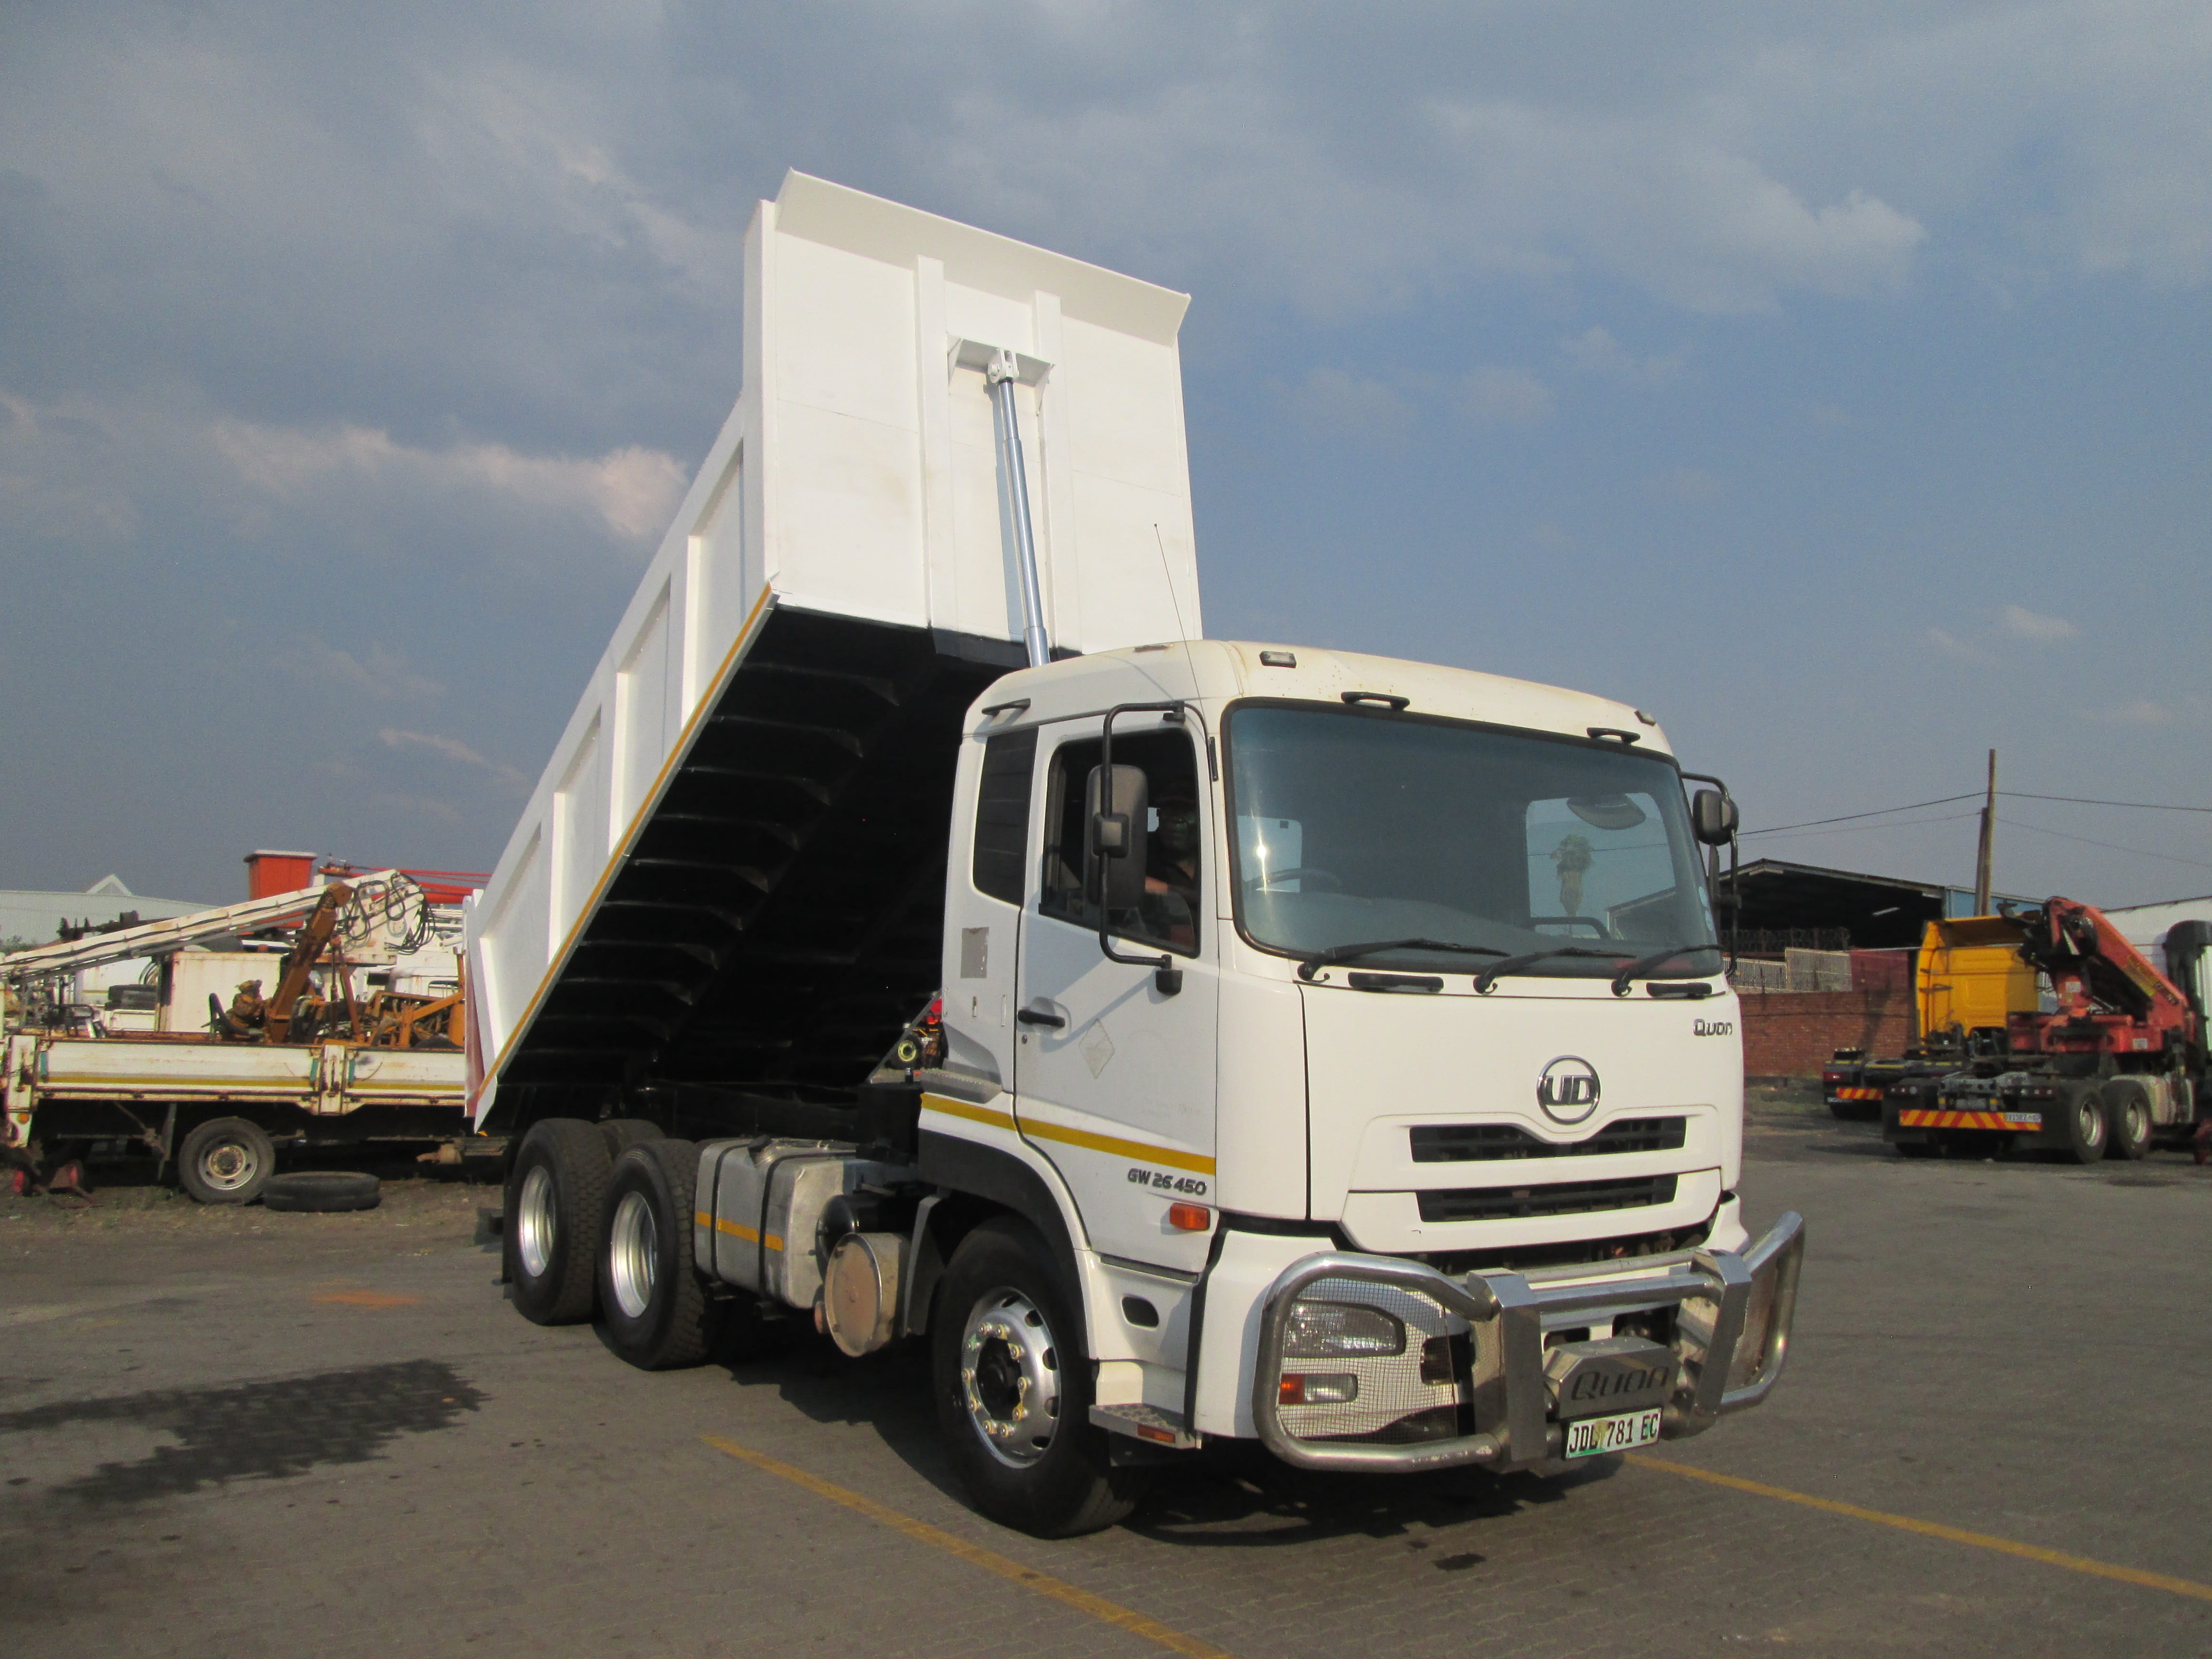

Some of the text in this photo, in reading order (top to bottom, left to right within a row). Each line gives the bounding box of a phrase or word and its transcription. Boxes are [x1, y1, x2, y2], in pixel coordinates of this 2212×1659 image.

[1693, 1019, 1732, 1036] Quon
[1539, 1075, 1598, 1106] UD
[1128, 1167, 1151, 1185] GW
[1569, 1413, 1659, 1453] JDL 781 EC
